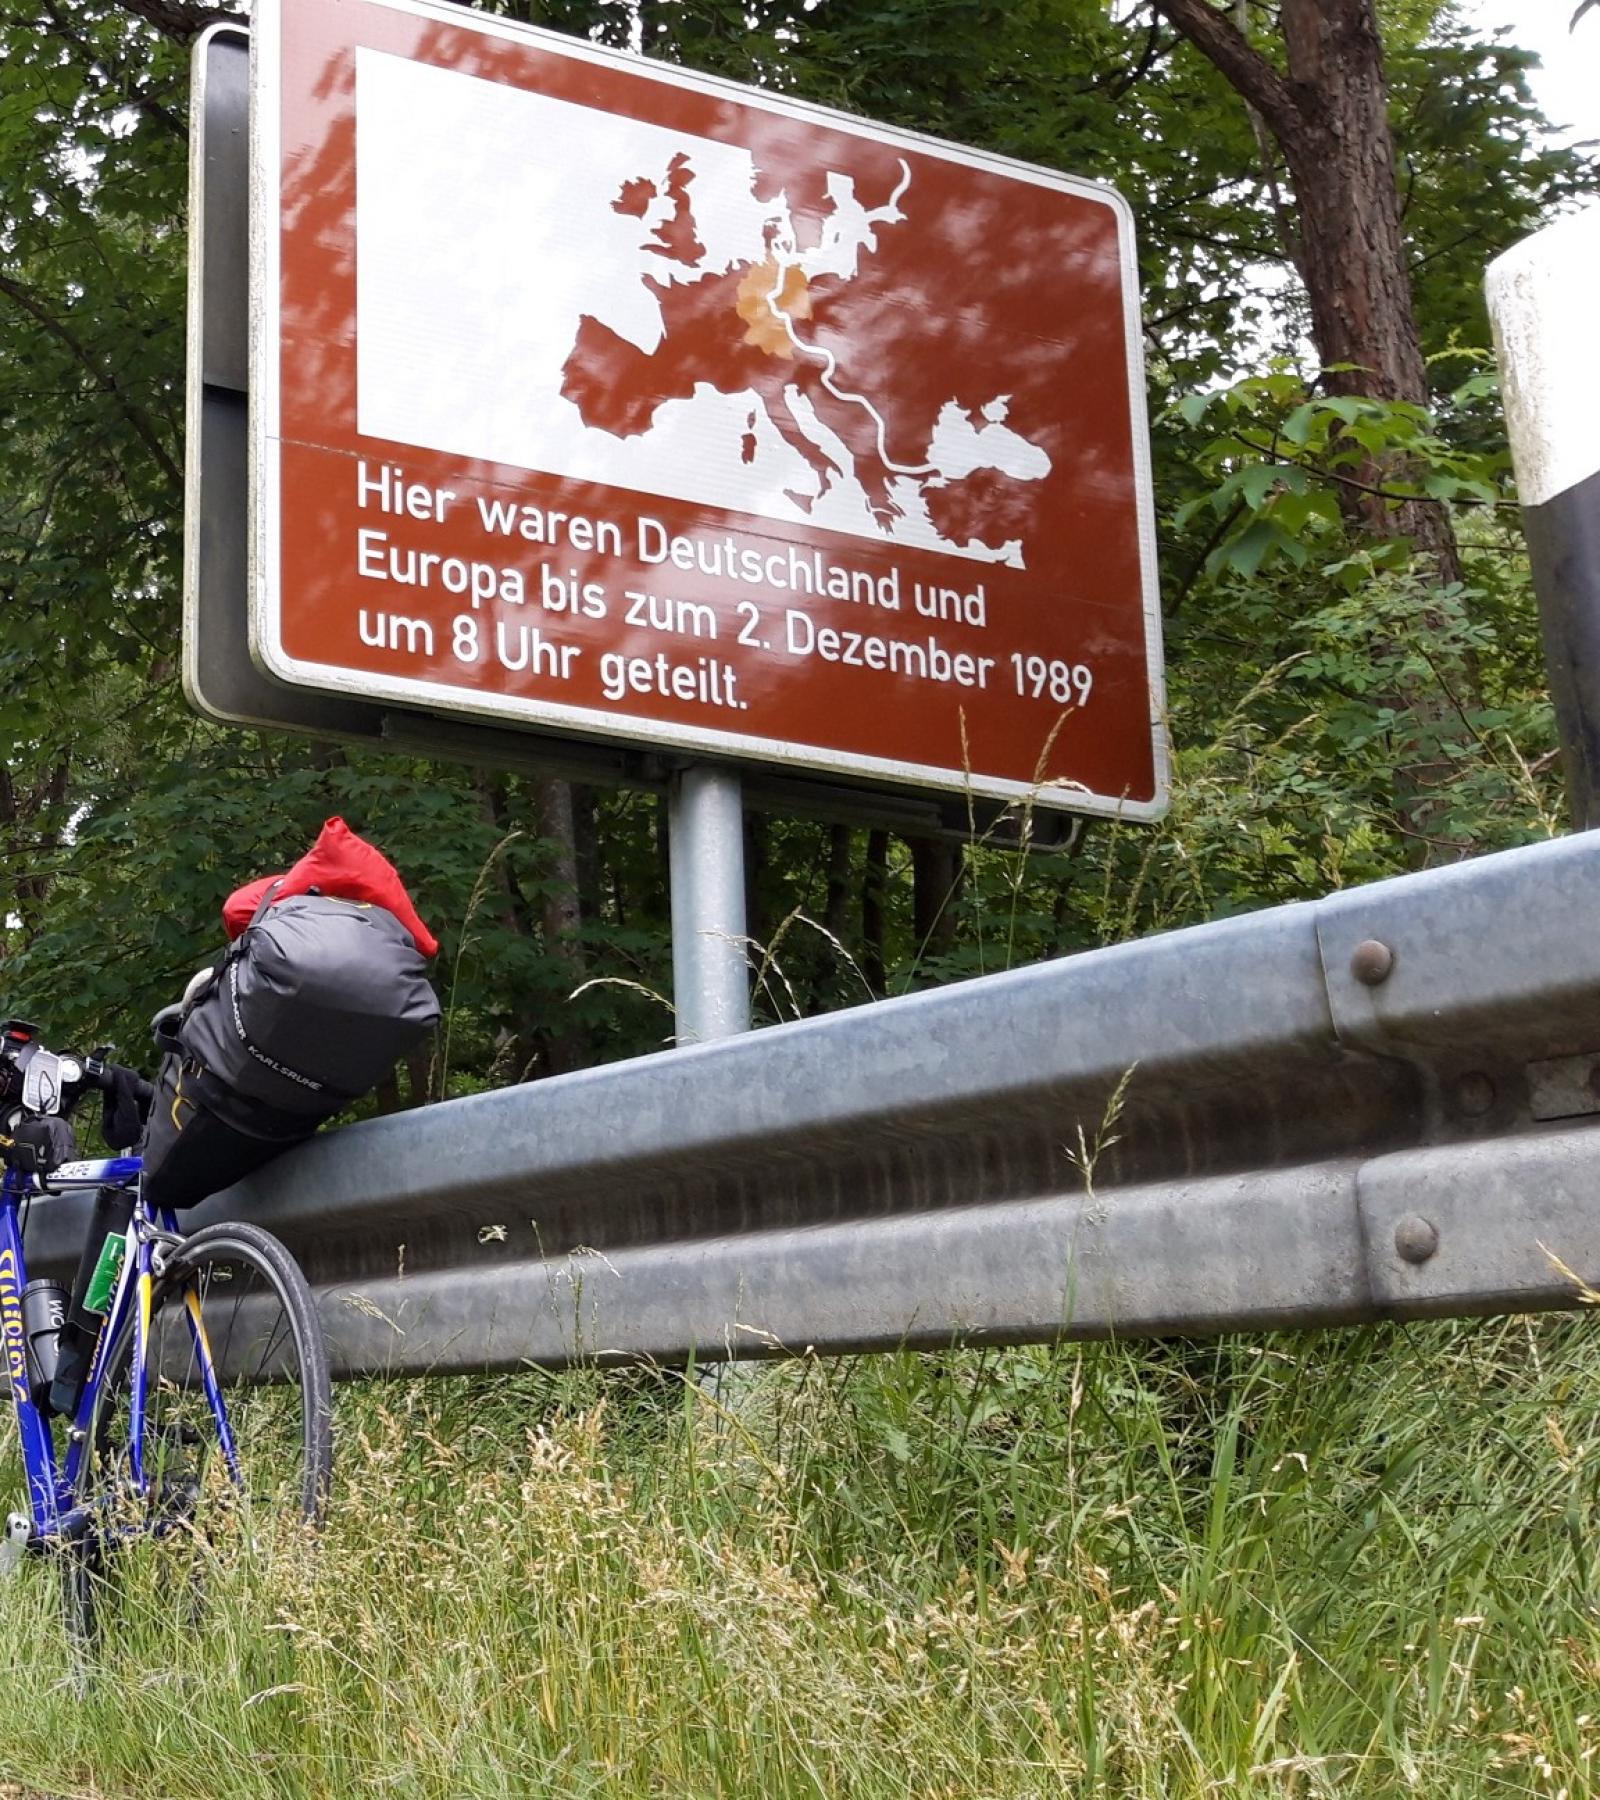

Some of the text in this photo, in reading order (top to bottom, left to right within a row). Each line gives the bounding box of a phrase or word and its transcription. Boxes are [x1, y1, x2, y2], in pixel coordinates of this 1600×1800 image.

[357, 461, 986, 627] Hier waren Deutschland und
[357, 528, 1093, 707] Europa bis zum 2. Dezember 1989
[359, 609, 749, 709] um 8 Uhr geteilt.
[247, 1045, 323, 1091] KARLSRUHE
